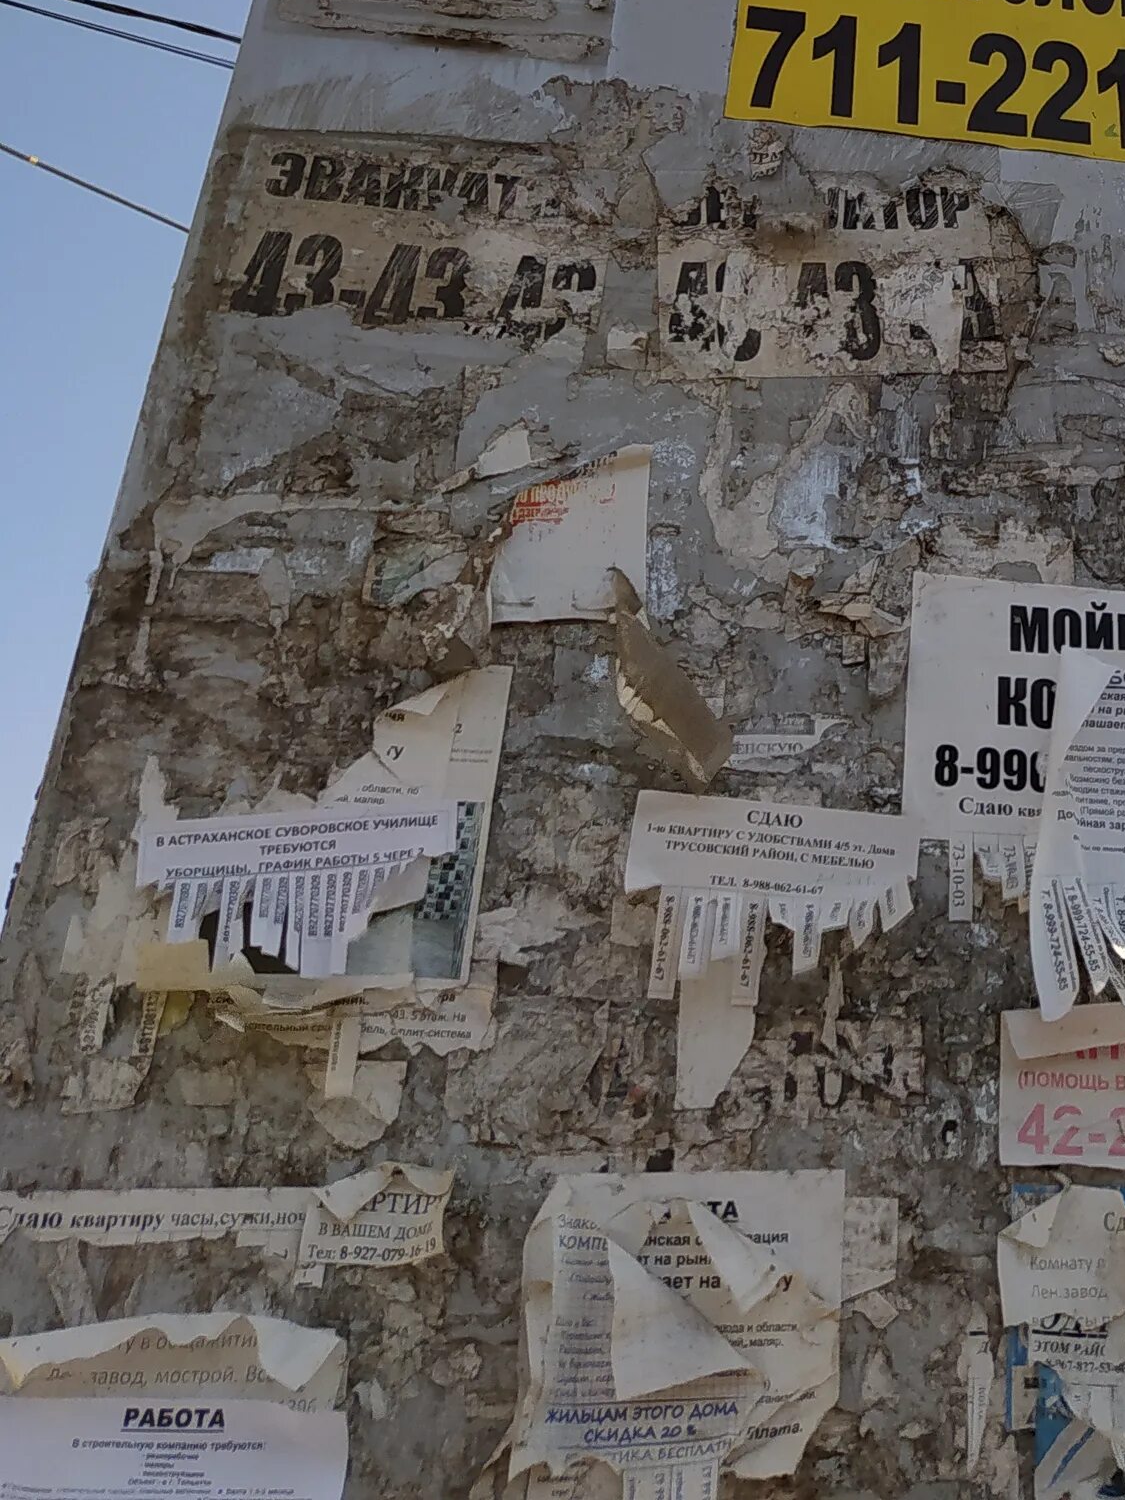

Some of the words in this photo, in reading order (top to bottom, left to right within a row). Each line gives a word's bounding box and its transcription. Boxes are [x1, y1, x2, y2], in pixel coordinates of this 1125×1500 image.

[1098, 707, 1112, 716] на
[958, 796, 1014, 816] Сдаю
[746, 809, 804, 830] СДАЮ
[156, 836, 165, 848] В
[168, 827, 272, 847] АСТРАХАНСКОЕ
[275, 818, 370, 839] СУВОРОВСКОЕ
[372, 814, 439, 831] УЧИЛИЩЕ
[668, 824, 734, 841] КВАРТИРУ
[735, 830, 746, 841] С
[747, 831, 834, 851] УДОБСТВАМИ
[834, 838, 851, 852] 4/5
[259, 840, 337, 857] ТРЕБУЮТСЯ
[664, 839, 750, 858] ТРУСОВСКИЙ
[750, 845, 799, 864] РАЙОН,
[800, 852, 810, 864] С
[811, 852, 876, 871] МЕБЕЛЬЮ
[165, 863, 252, 879] УБОРЩИЦЫ,
[258, 857, 313, 874] ГРАФИК
[315, 853, 370, 870] РАБОТЫ
[952, 843, 966, 908] 73-10-03
[741, 877, 825, 896] 8-988-062-61-67
[1017, 1069, 1111, 1094] (ПОМОЩЬ
[69, 1211, 164, 1233] квартиру
[318, 1221, 329, 1236] В
[331, 1222, 392, 1240] ВАШЕМ
[307, 1243, 336, 1260] Тел:
[339, 1236, 437, 1262] 8-927-079-16-19
[654, 1255, 672, 1266] на
[1029, 1256, 1093, 1274] Комнату
[699, 1275, 722, 1290] на
[122, 1407, 227, 1430] РАБОТА
[545, 1404, 629, 1425] ЖИЛЬЦАМ
[631, 1402, 685, 1420] ЭТОГО
[688, 1400, 740, 1419] ДОМА
[72, 1437, 80, 1449] В
[81, 1438, 155, 1453] строительную
[156, 1440, 208, 1452] компанию
[583, 1428, 658, 1445] СКИДКА
[660, 1425, 682, 1439] 20
